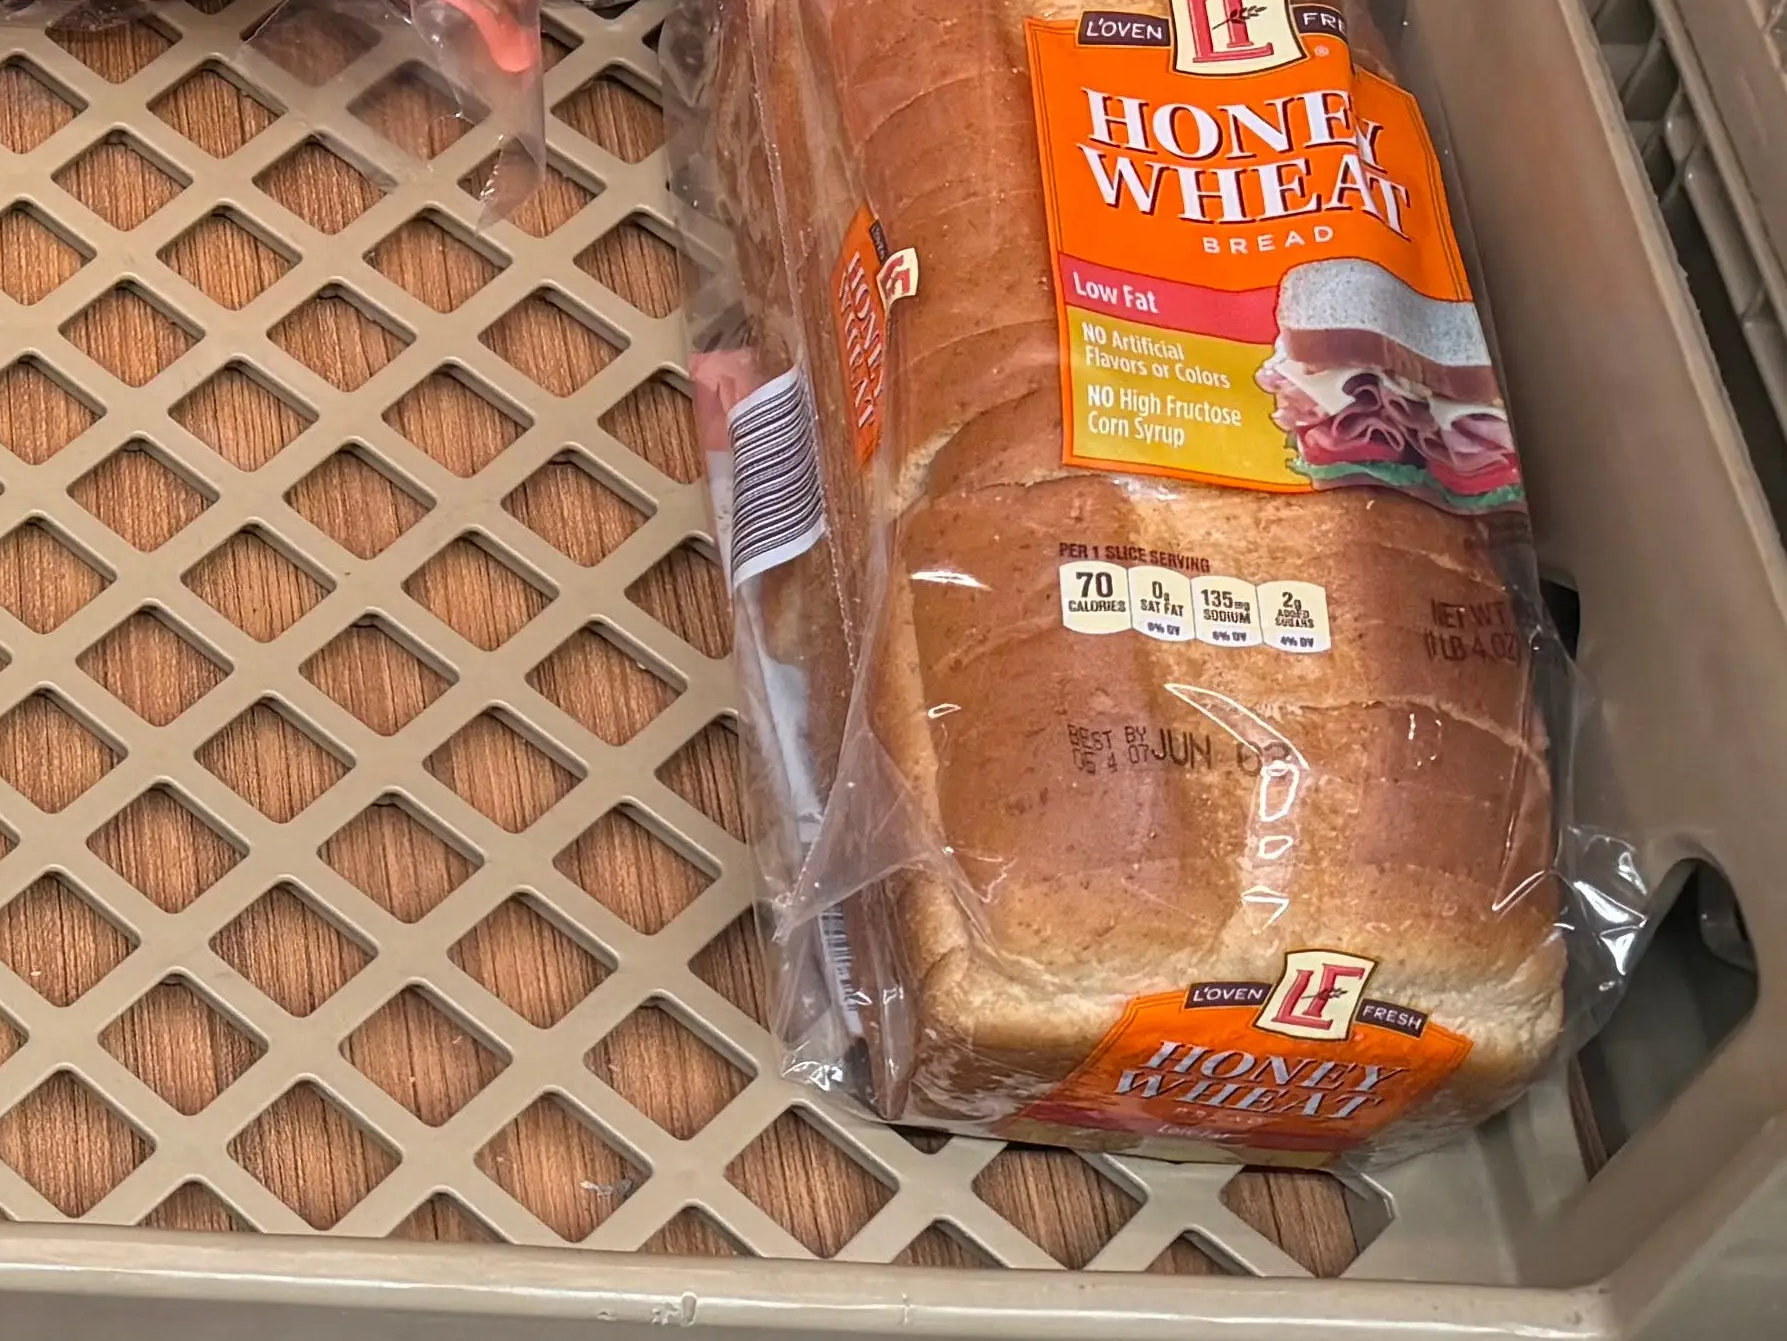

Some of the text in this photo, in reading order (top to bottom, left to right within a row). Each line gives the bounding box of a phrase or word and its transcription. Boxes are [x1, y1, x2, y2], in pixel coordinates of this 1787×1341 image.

[1086, 18, 1163, 41] L'OVEN
[1303, 11, 1348, 36] FRE
[1081, 87, 1387, 173] HONEY
[1077, 143, 1412, 243] WHEAT
[1202, 226, 1334, 255] BREAD
[1073, 271, 1159, 313] Low Fat
[847, 251, 884, 399] HONEY
[1082, 322, 1185, 360] NO Artificial
[1085, 346, 1231, 389] Flavors or Colors
[1087, 384, 1242, 427] NO High Fructose
[1088, 412, 1185, 448] Corn Syrup
[1059, 542, 1210, 573] PER 1 SLICE SERVING
[1075, 571, 1113, 598] 70
[1068, 600, 1126, 613] CALORIES
[1140, 600, 1184, 617] SAT FAT
[1200, 589, 1250, 611] 135mg
[1282, 591, 1302, 611] 2g
[1202, 608, 1251, 624] SODIUM
[1068, 724, 1146, 751] BEST BY
[1152, 728, 1211, 769] JUN
[1129, 744, 1149, 764] 07
[1192, 986, 1263, 1002] L'OVEN
[1362, 1004, 1423, 1029] FRESH
[1142, 1038, 1411, 1093] HONEY
[1114, 1068, 1383, 1119] WHEAT
